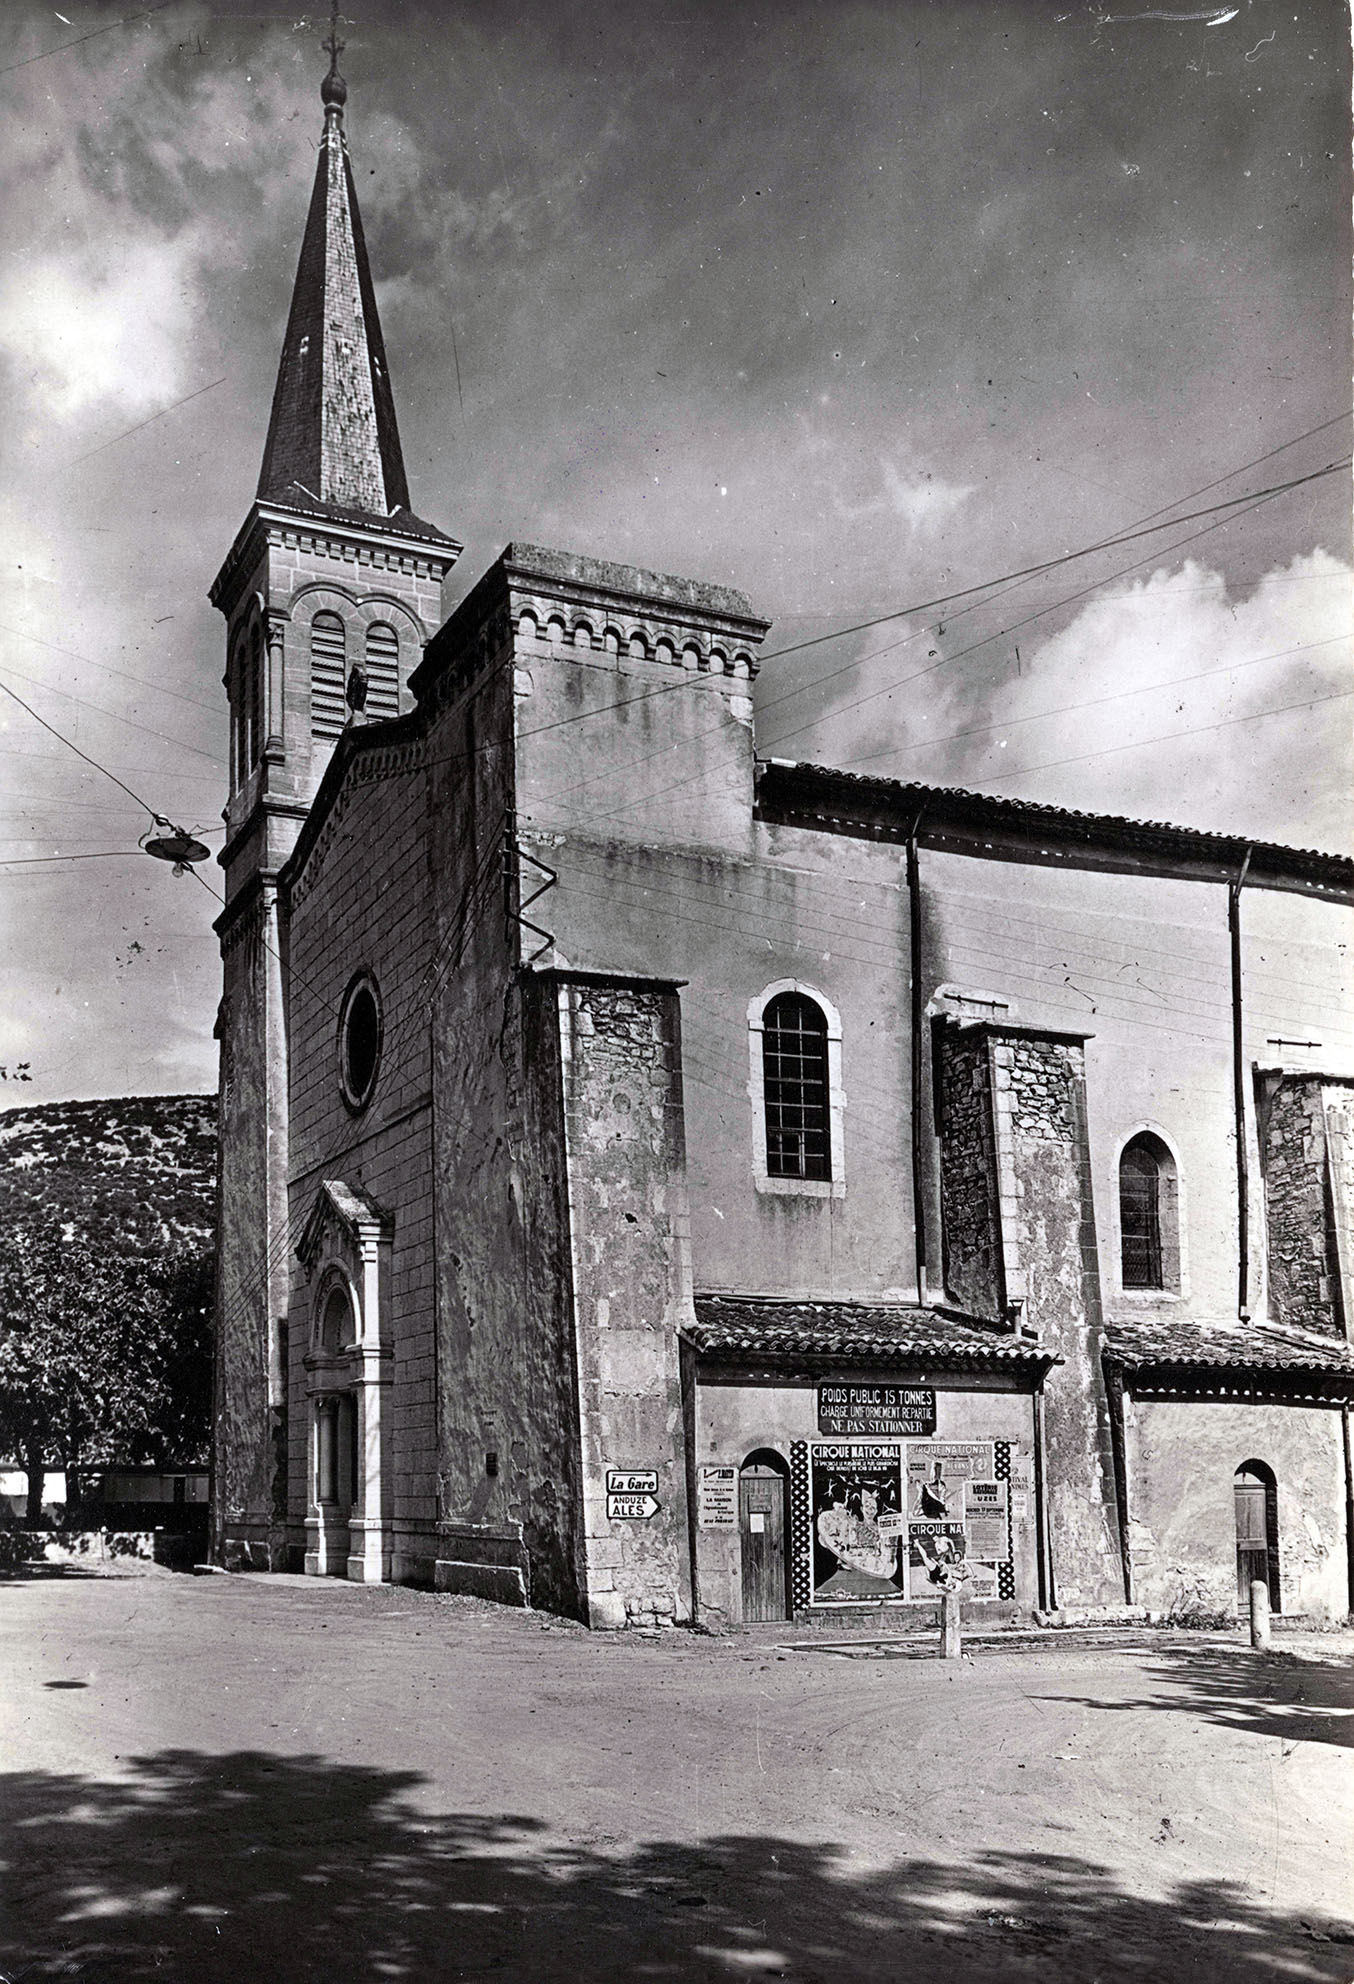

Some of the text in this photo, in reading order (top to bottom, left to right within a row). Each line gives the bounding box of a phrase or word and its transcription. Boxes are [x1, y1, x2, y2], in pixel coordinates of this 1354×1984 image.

[821, 1388, 848, 1403] POIDS
[850, 1389, 881, 1404] PUBLIC
[899, 1390, 933, 1405] TONNES
[820, 1405, 933, 1420] CHARGE UNIFORMEMENT REPARTIE
[831, 1420, 923, 1433] NE PAS STATIONNER
[812, 1445, 900, 1459] CIRQUE NATIONAL
[909, 1445, 991, 1455] CIRQUE NATIONAL
[611, 1477, 655, 1489] La Gare
[613, 1496, 648, 1504] ANDUZE
[612, 1505, 645, 1516] ALES
[910, 1524, 946, 1535] CIRQUE
